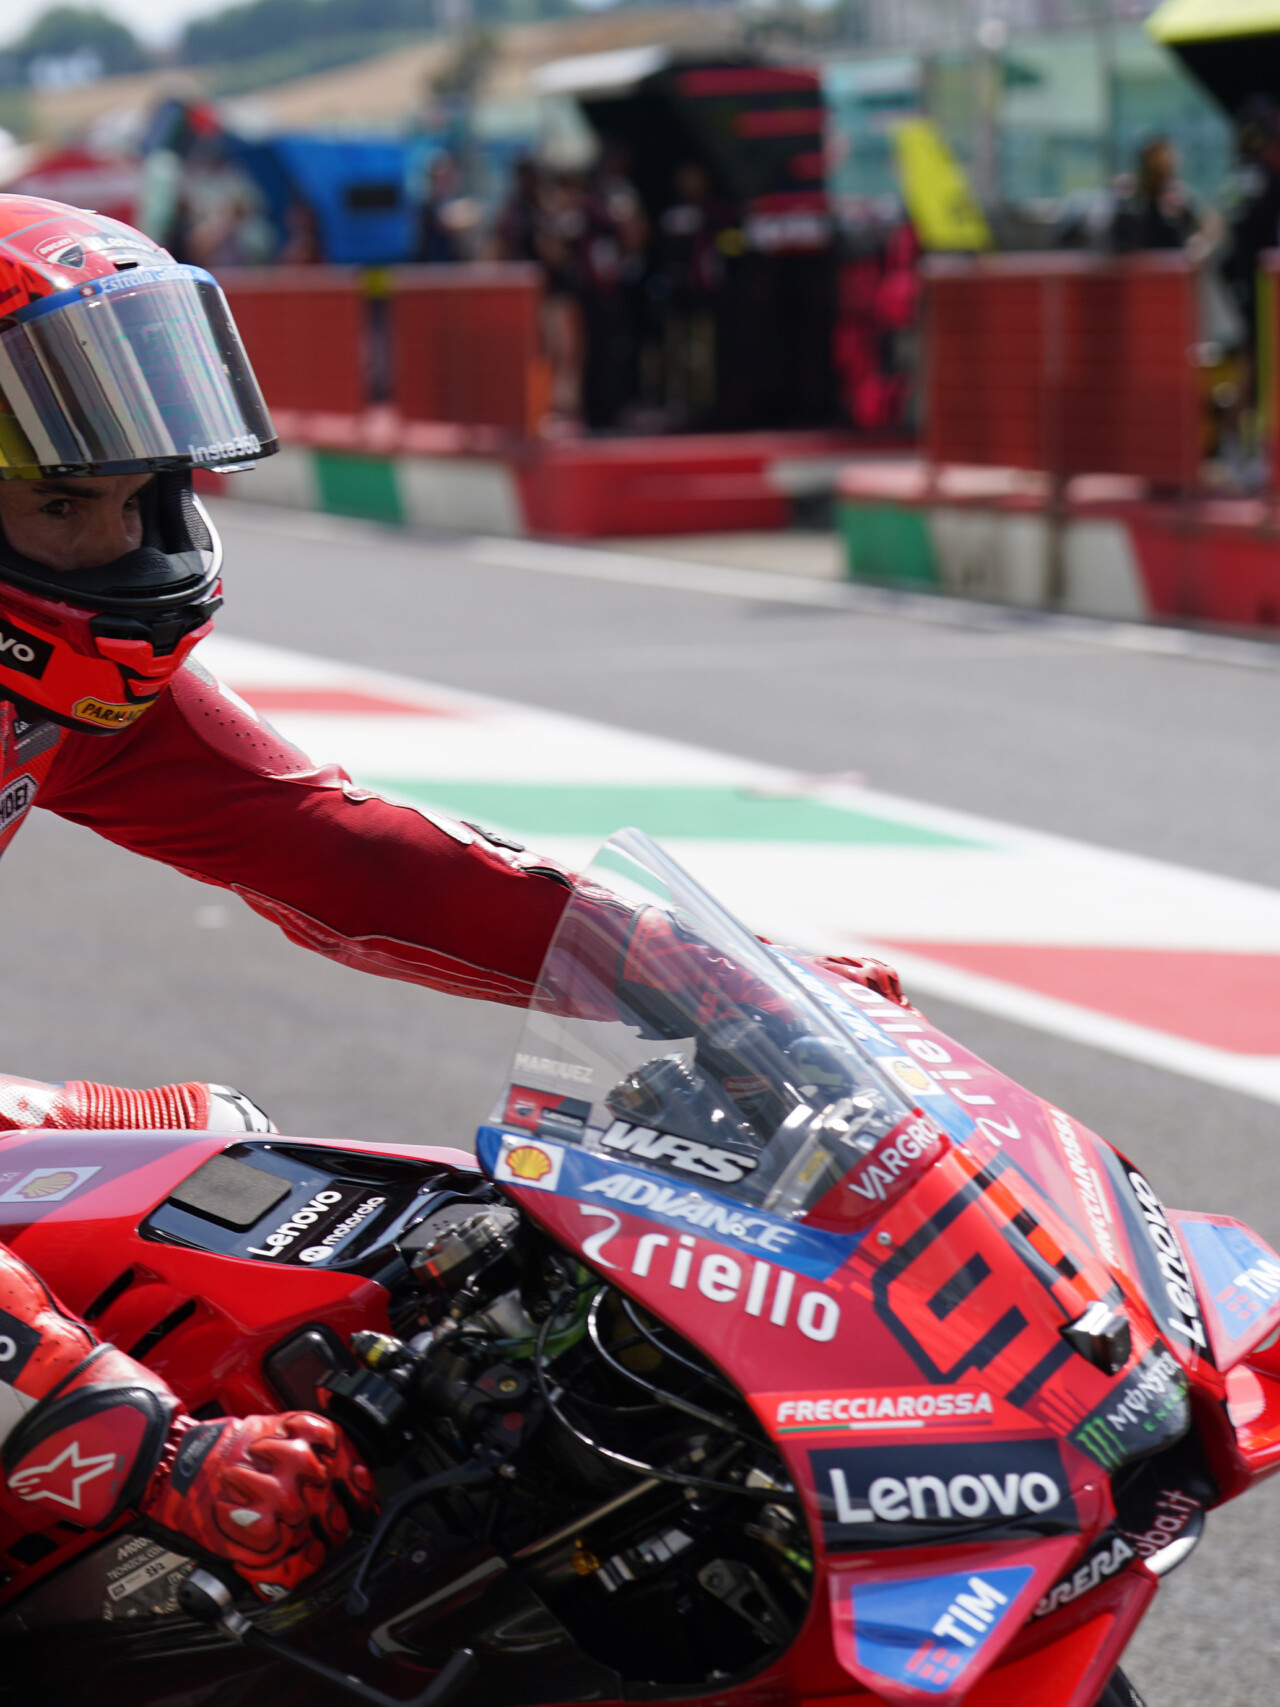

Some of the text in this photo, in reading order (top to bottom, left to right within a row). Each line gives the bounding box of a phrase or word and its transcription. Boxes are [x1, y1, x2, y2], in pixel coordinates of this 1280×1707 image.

[188, 434, 262, 463] Insta360
[599, 1120, 758, 1183] WRS
[246, 1190, 343, 1258] Lenovo
[322, 1196, 388, 1246] motorola
[580, 1173, 798, 1254] ADVANCE
[631, 1231, 841, 1343] riello
[1128, 1171, 1207, 1349] Lenovo
[777, 1391, 994, 1423] FRECCIAROSSA
[1106, 1350, 1183, 1432] MONSTER
[829, 1468, 1061, 1524] Lenovo
[933, 1577, 1009, 1648] TIM
